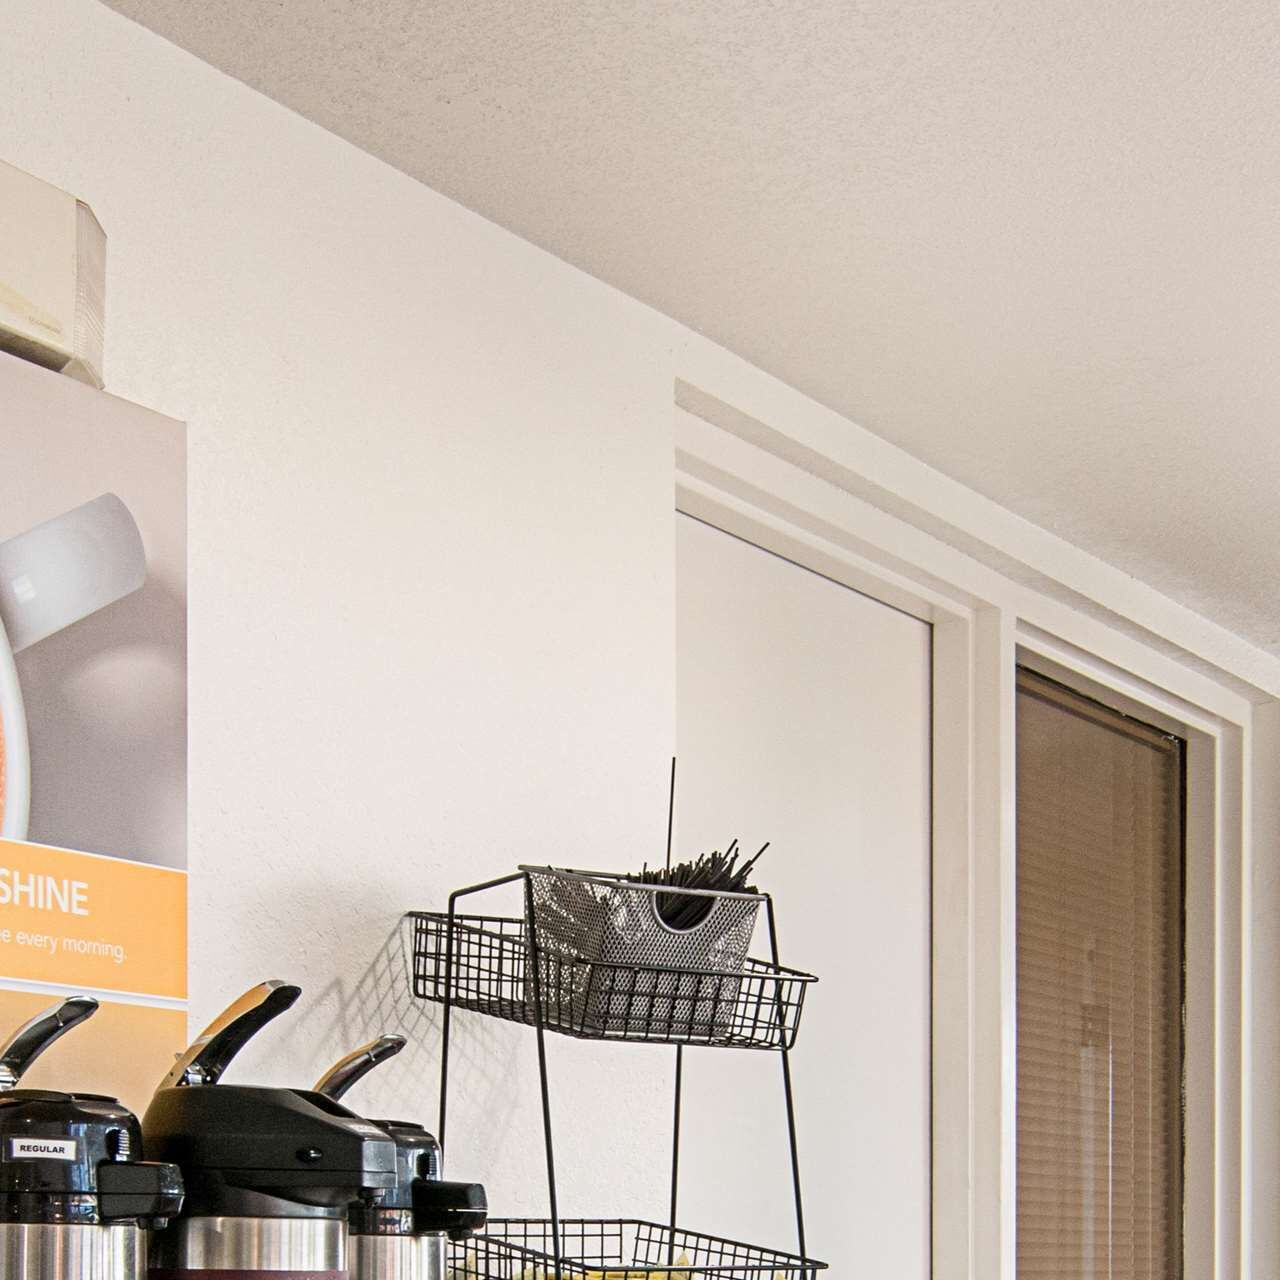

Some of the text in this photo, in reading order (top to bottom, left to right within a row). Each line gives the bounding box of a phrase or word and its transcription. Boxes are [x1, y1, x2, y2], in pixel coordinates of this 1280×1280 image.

[16, 931, 58, 955] every
[63, 937, 128, 964] morning.
[20, 1144, 65, 1153] REGULAR
